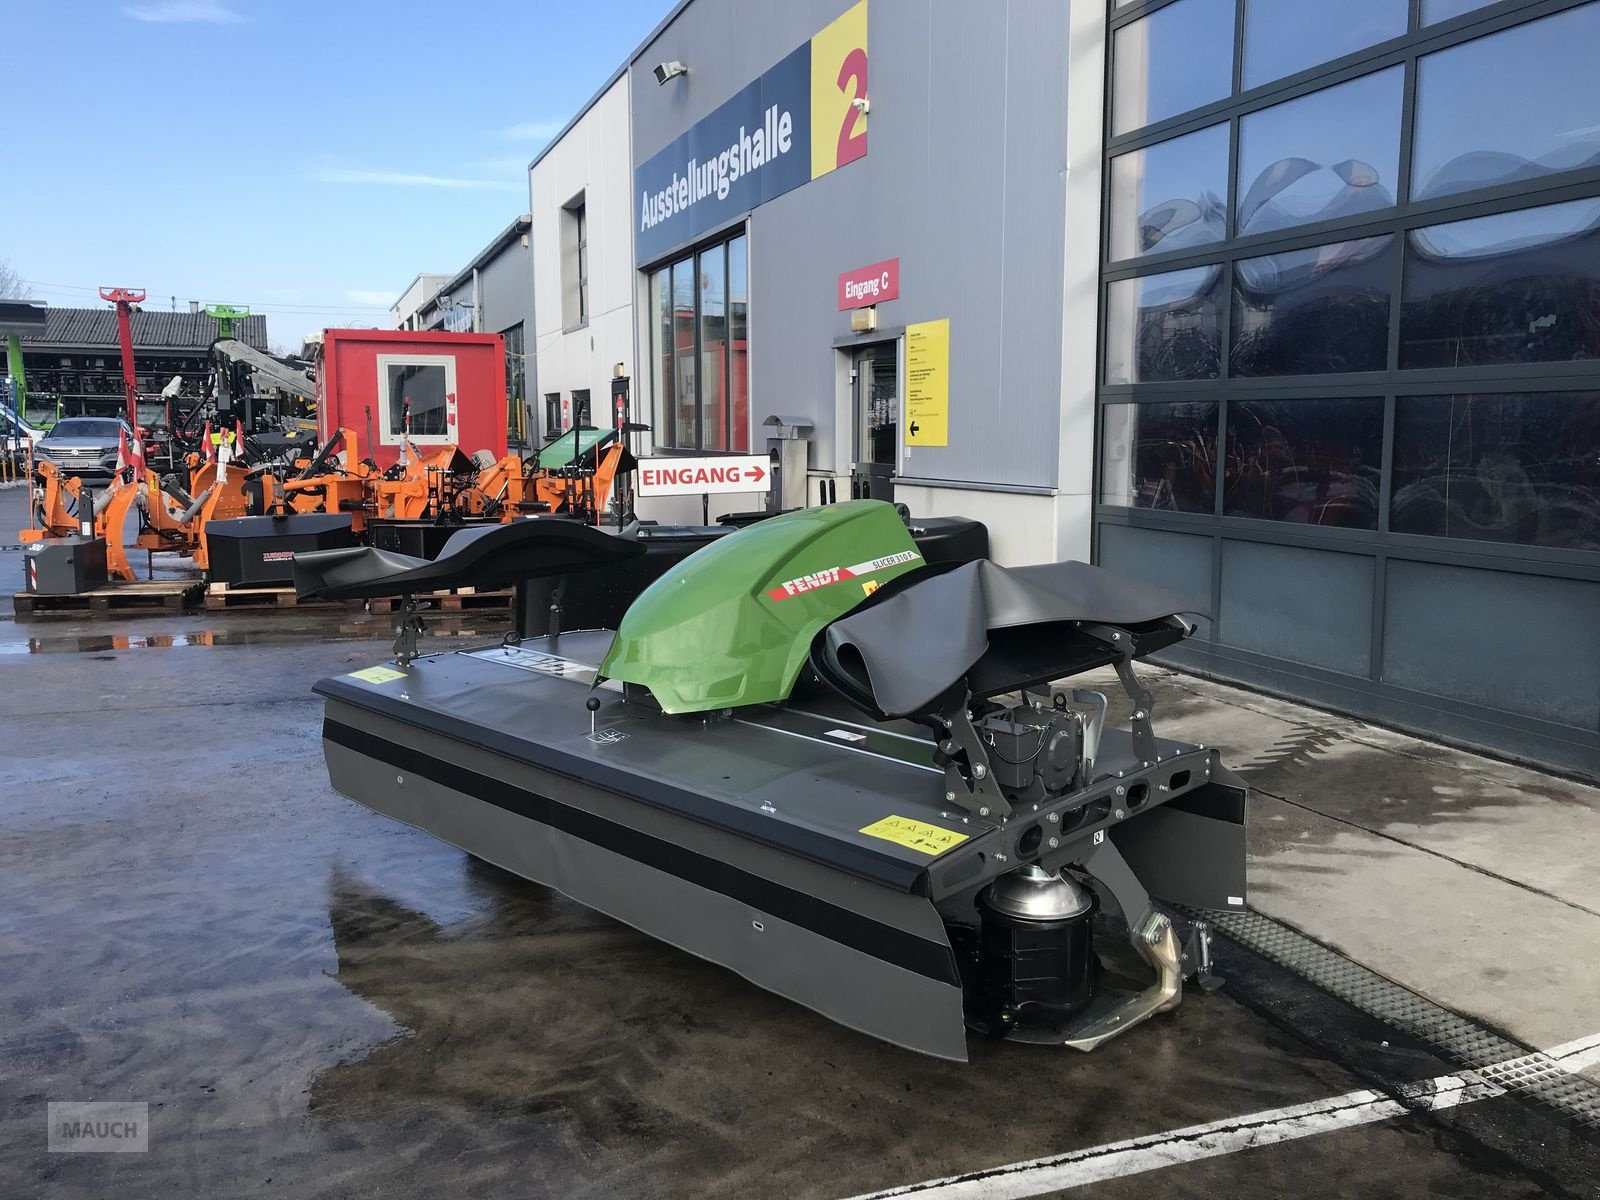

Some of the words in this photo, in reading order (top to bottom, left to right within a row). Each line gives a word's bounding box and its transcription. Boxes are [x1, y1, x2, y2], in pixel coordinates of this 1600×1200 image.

[641, 104, 792, 232] Ausstellungshalle
[836, 48, 867, 169] 2
[845, 278, 880, 300] Eingang
[881, 271, 889, 290] C
[642, 467, 740, 486] EINGANG
[781, 566, 840, 596] FENDT
[872, 557, 896, 569] SLICER
[895, 553, 909, 563] 310
